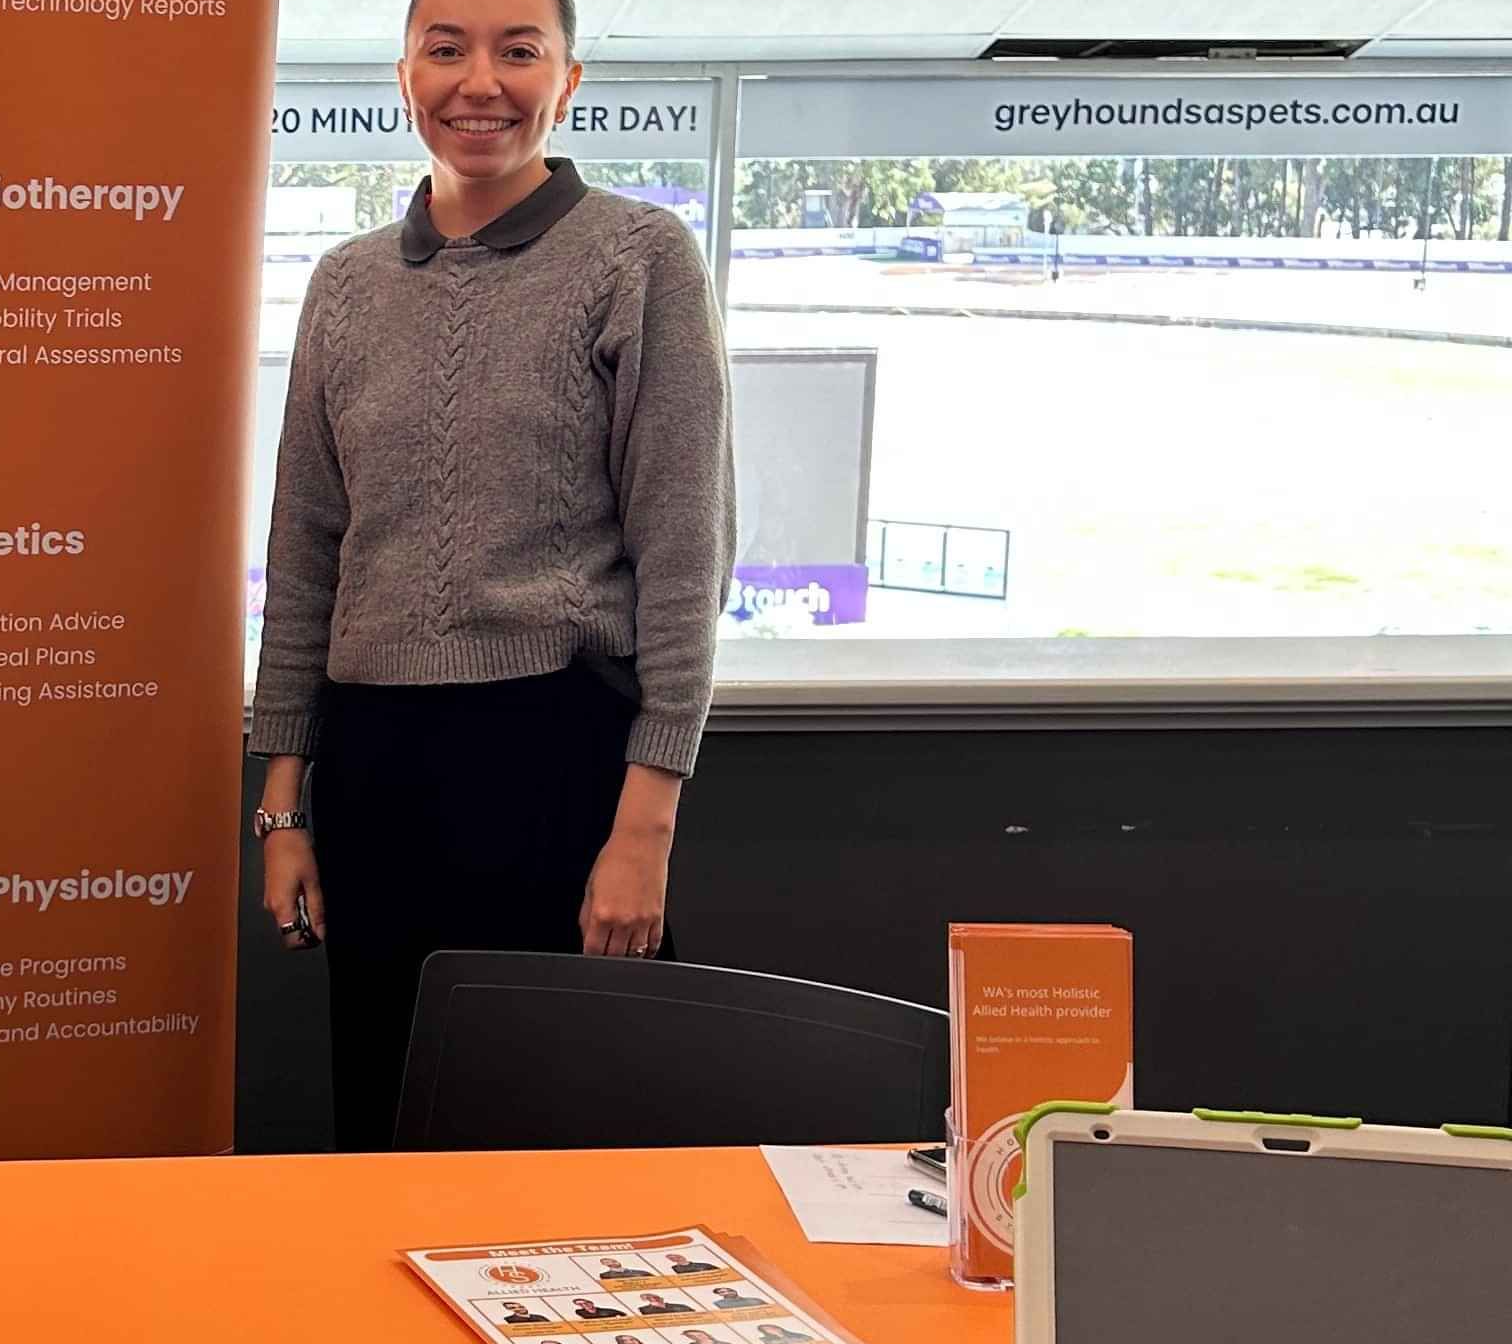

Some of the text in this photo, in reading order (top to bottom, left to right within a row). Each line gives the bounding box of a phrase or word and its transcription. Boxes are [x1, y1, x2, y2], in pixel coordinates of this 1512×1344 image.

[619, 106, 697, 132] DAY!
[994, 98, 1460, 132] greyhoundsaspets.com.au
[64, 308, 123, 329] Trials
[34, 345, 183, 365] Assessments
[48, 611, 126, 632] Advice
[35, 645, 96, 666] Plans
[38, 679, 160, 701] Assistance
[19, 954, 128, 981] Programs
[23, 986, 118, 1009] Routines
[982, 986, 1101, 1000] WA's most Holistic
[973, 1005, 1113, 1020] Allied Health provider
[45, 1013, 200, 1041] Accountability
[488, 1249, 537, 1258] Meet
[538, 1246, 574, 1254] the
